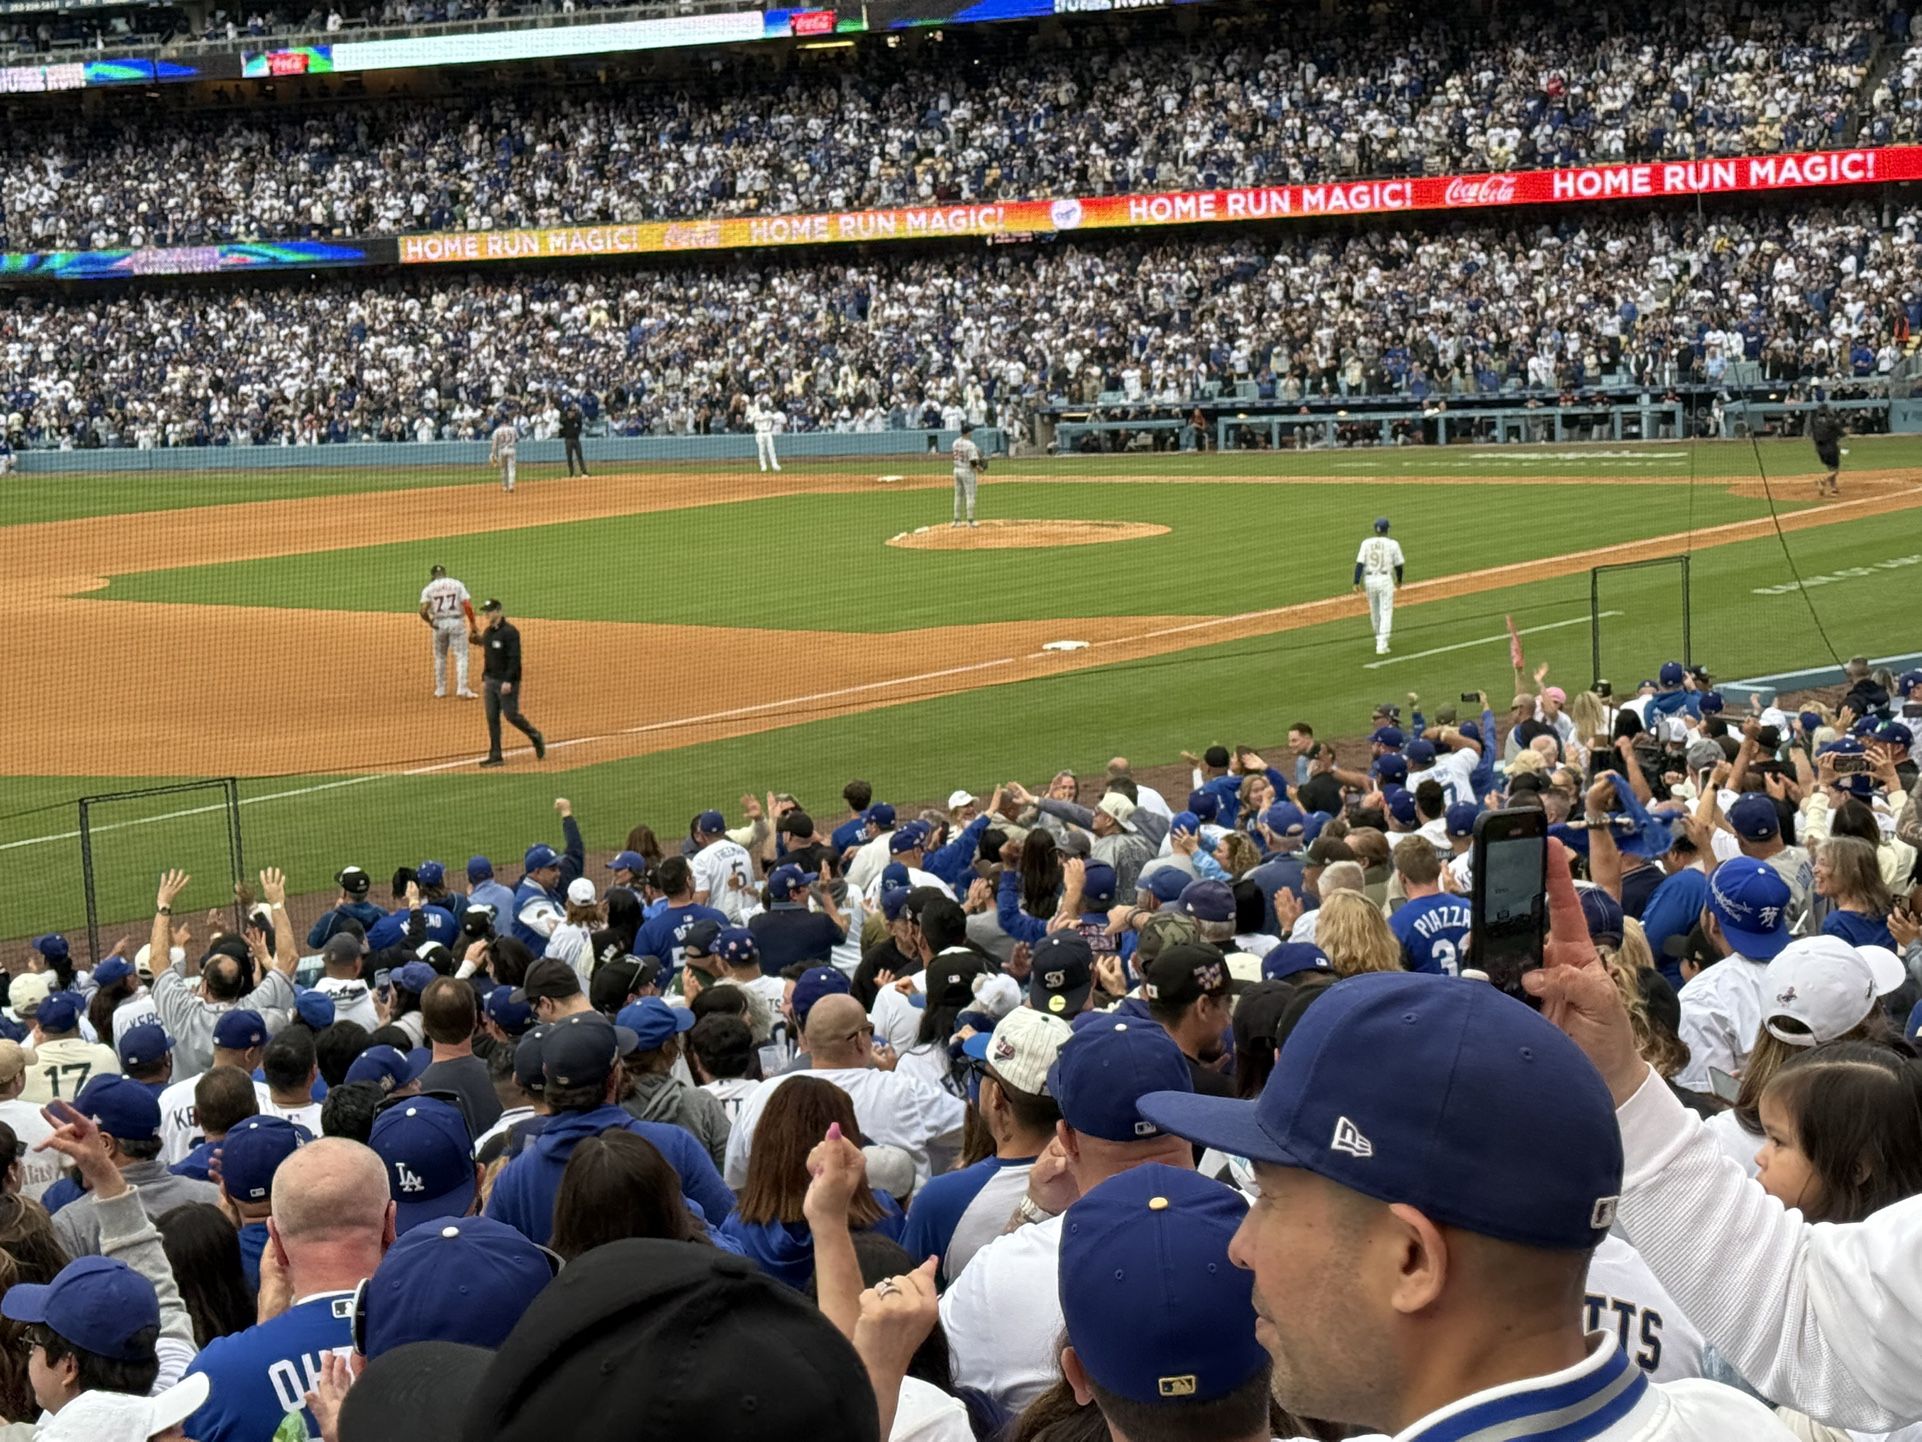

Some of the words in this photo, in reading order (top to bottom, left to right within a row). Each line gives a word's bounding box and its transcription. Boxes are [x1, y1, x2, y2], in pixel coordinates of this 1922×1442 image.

[1553, 167, 1652, 198] HOME
[1664, 162, 1736, 192] RUN
[1749, 152, 1875, 186] MAGIC!
[1129, 195, 1217, 222] HOME
[1227, 189, 1291, 216] RUN
[1302, 181, 1413, 211] MAGIC!
[406, 236, 478, 259] HOME
[487, 233, 540, 255] RUN
[548, 227, 639, 252] MAGIC!
[750, 217, 829, 243] HOME
[839, 213, 896, 238] RUN
[906, 207, 1005, 235] MAGIC!
[434, 594, 456, 612] 77
[1413, 905, 1471, 939] PIAZZA
[44, 1061, 91, 1101] 17
[395, 1162, 425, 1192] LA
[1584, 1292, 1663, 1374] TTS
